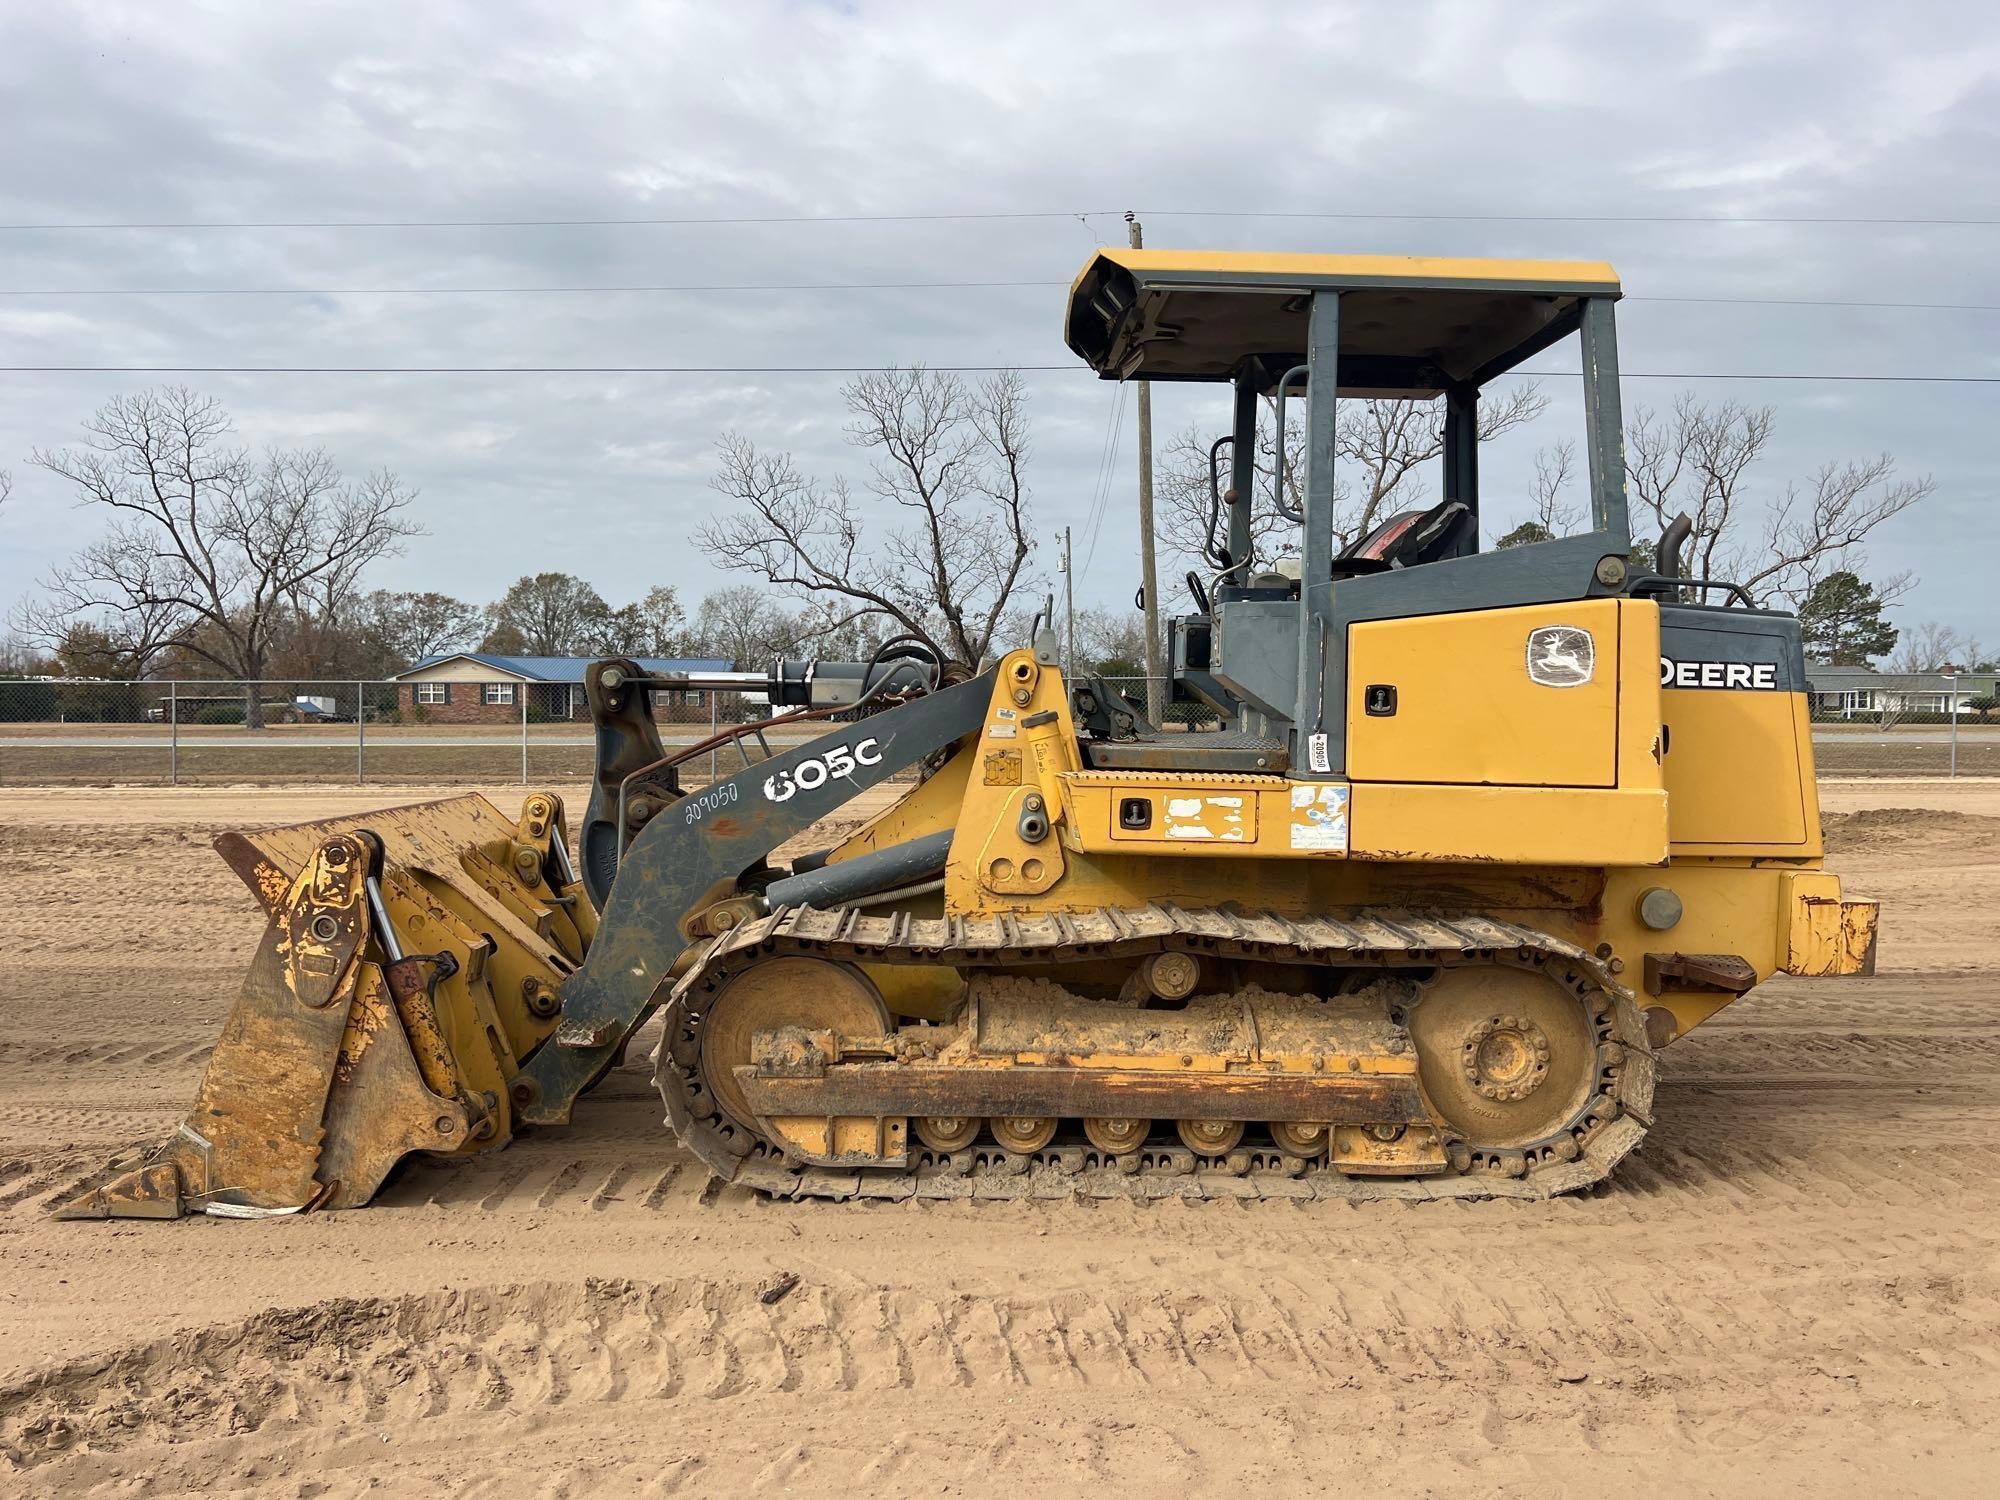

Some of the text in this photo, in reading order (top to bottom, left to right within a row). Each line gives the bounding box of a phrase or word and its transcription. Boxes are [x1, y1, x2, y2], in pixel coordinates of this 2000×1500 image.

[763, 738, 883, 802] 605C
[1315, 741, 1326, 768] 209050
[685, 782, 738, 825] 209050
